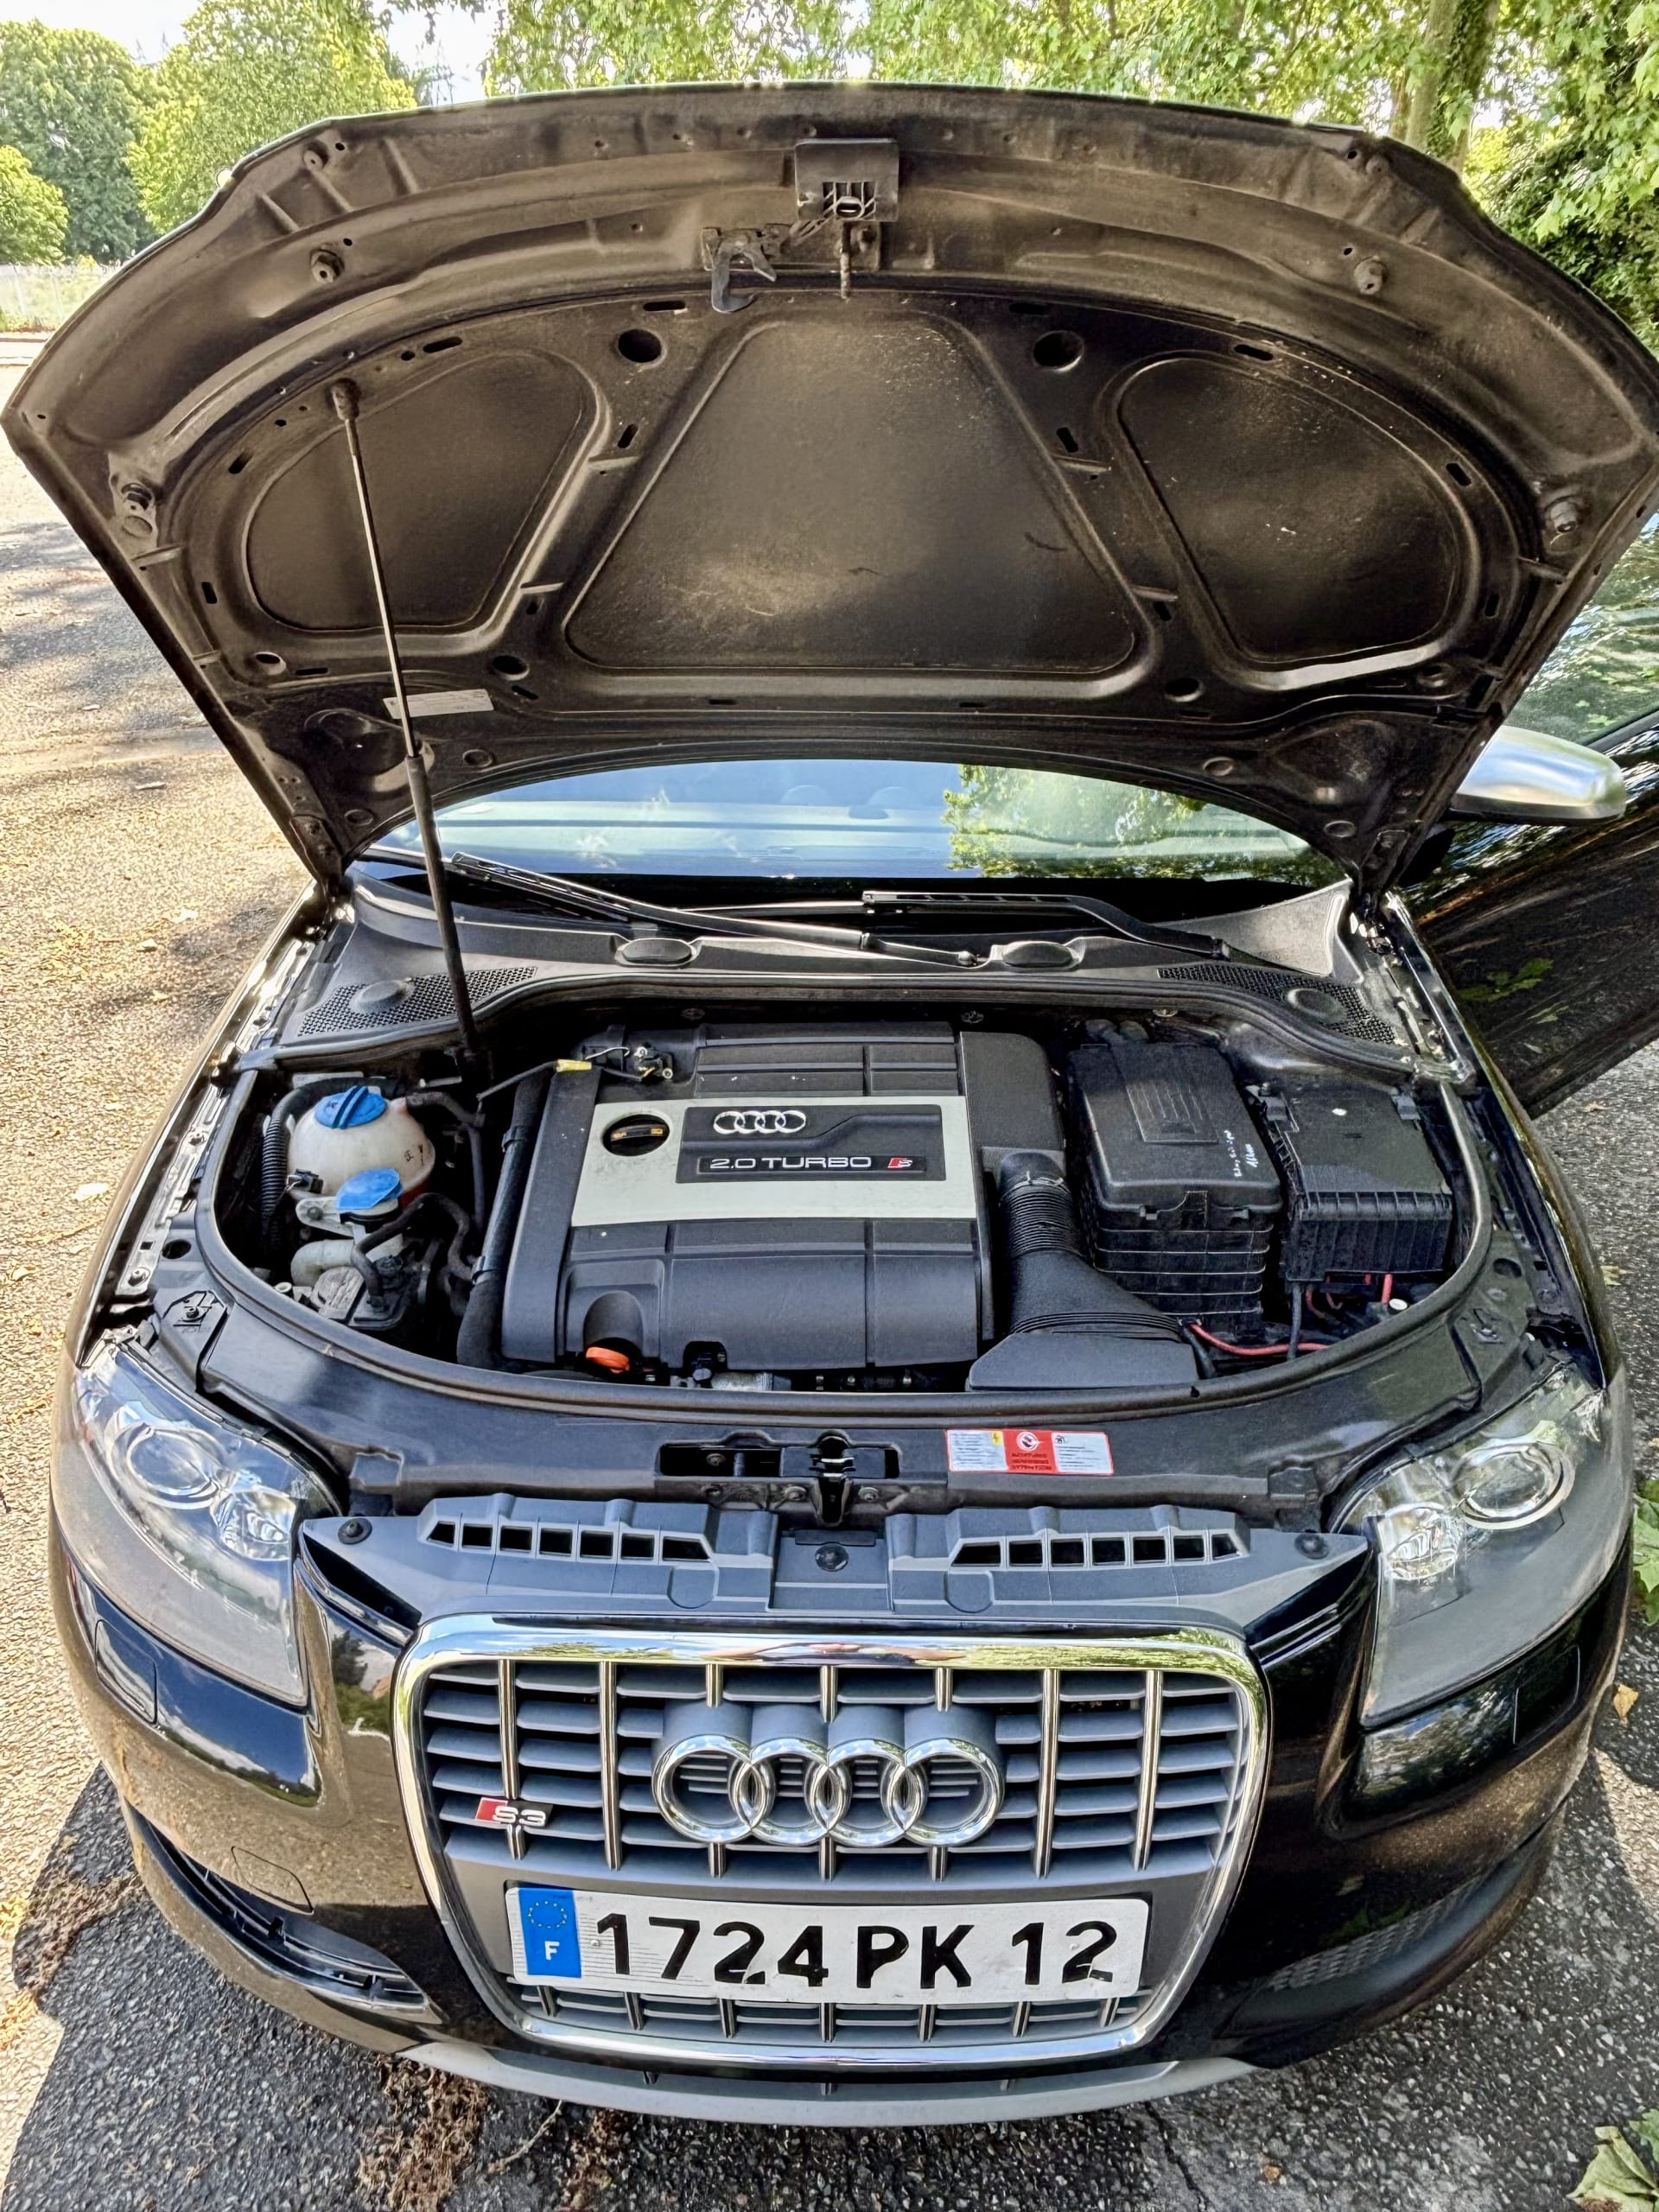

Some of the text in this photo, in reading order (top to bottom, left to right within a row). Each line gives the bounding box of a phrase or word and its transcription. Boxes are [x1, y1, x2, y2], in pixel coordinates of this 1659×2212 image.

[709, 1158, 757, 1169] 2.0
[761, 1156, 872, 1169] TURBO
[492, 1804, 547, 1827] S3
[544, 1941, 560, 1961] F
[597, 1912, 1117, 1990] 1724 PK 12
